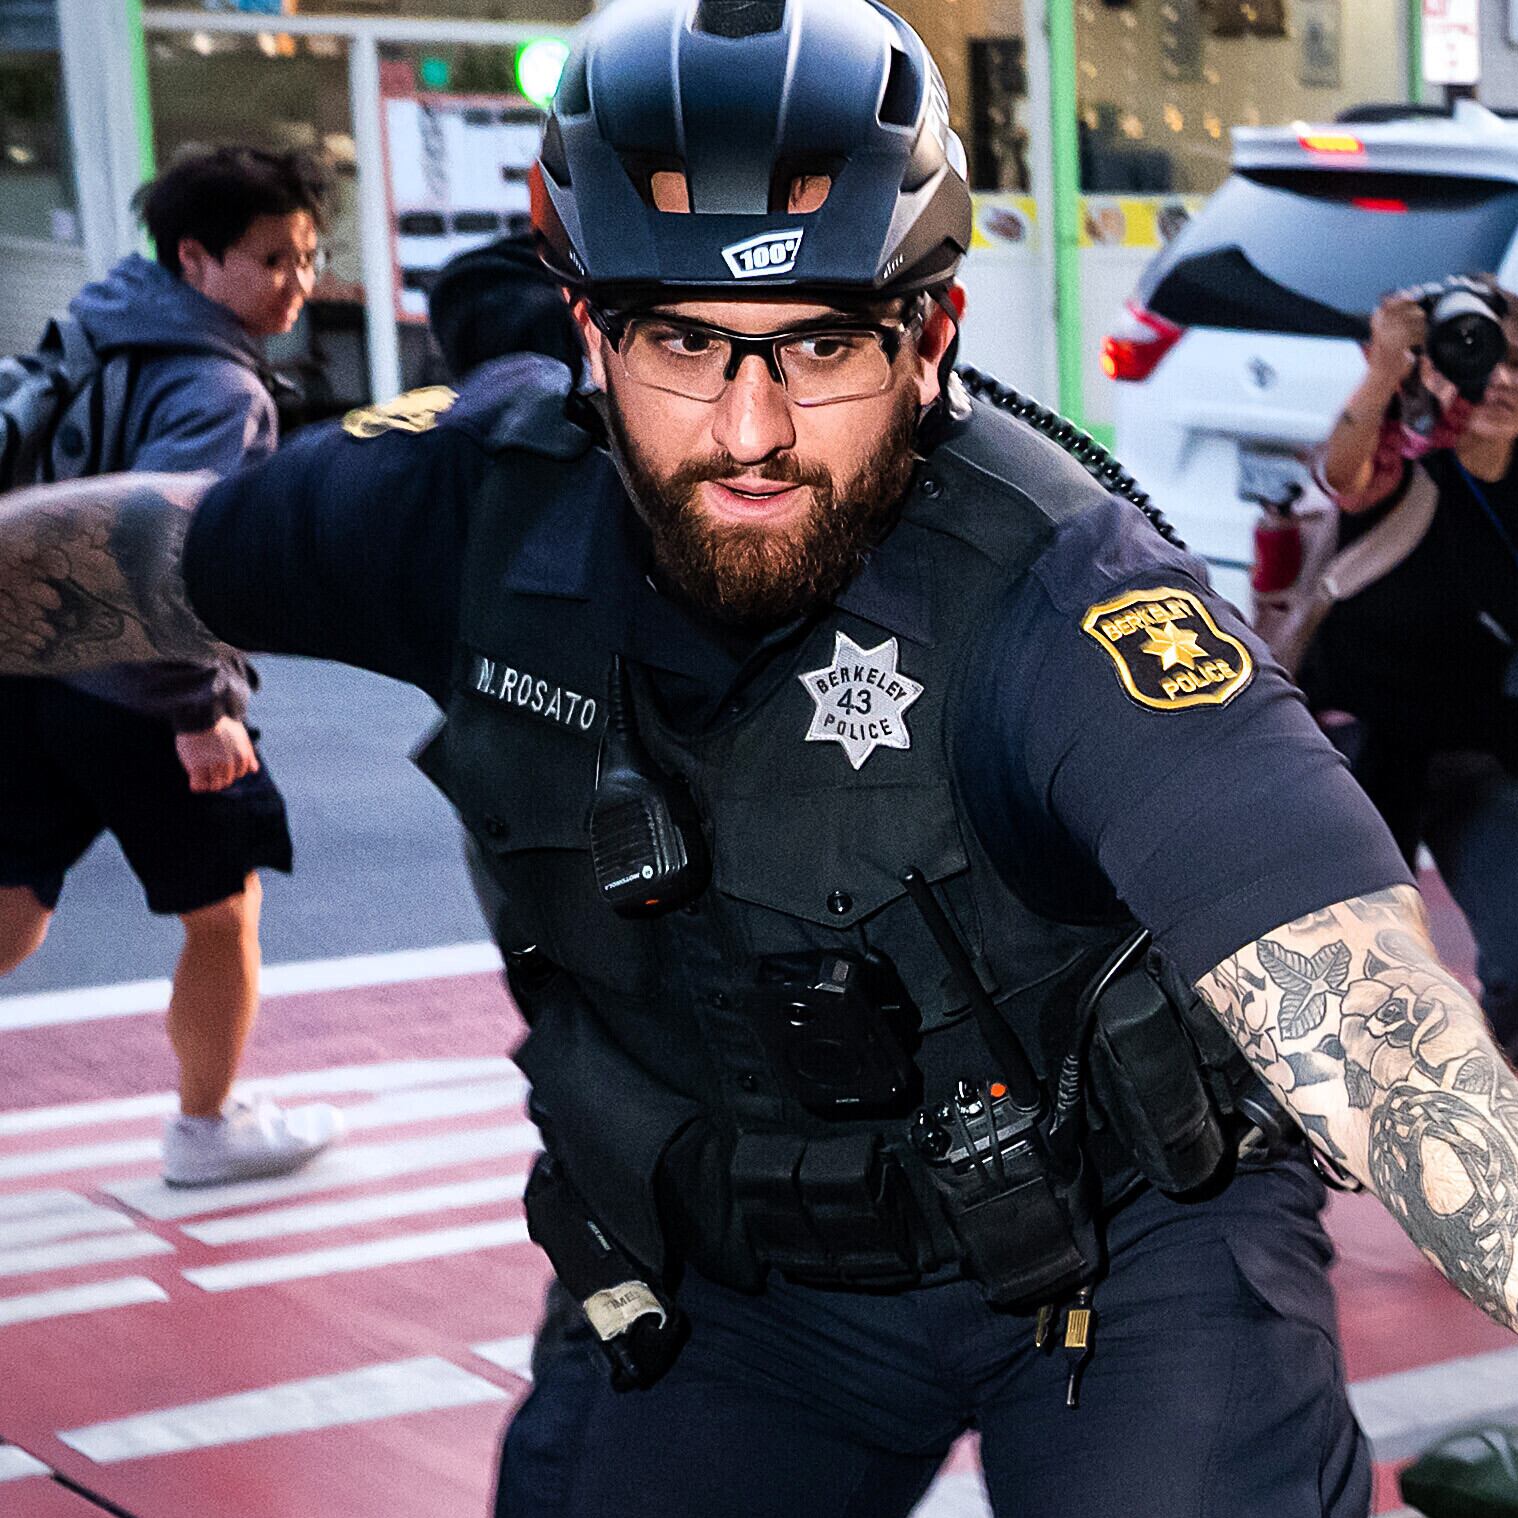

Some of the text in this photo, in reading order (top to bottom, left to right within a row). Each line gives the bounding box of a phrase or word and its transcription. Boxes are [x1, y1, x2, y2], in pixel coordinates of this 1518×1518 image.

[816, 665, 908, 702] BERKELEY
[1159, 658, 1239, 701] POLICE
[836, 688, 873, 716] 43
[823, 712, 893, 741] POLICE
